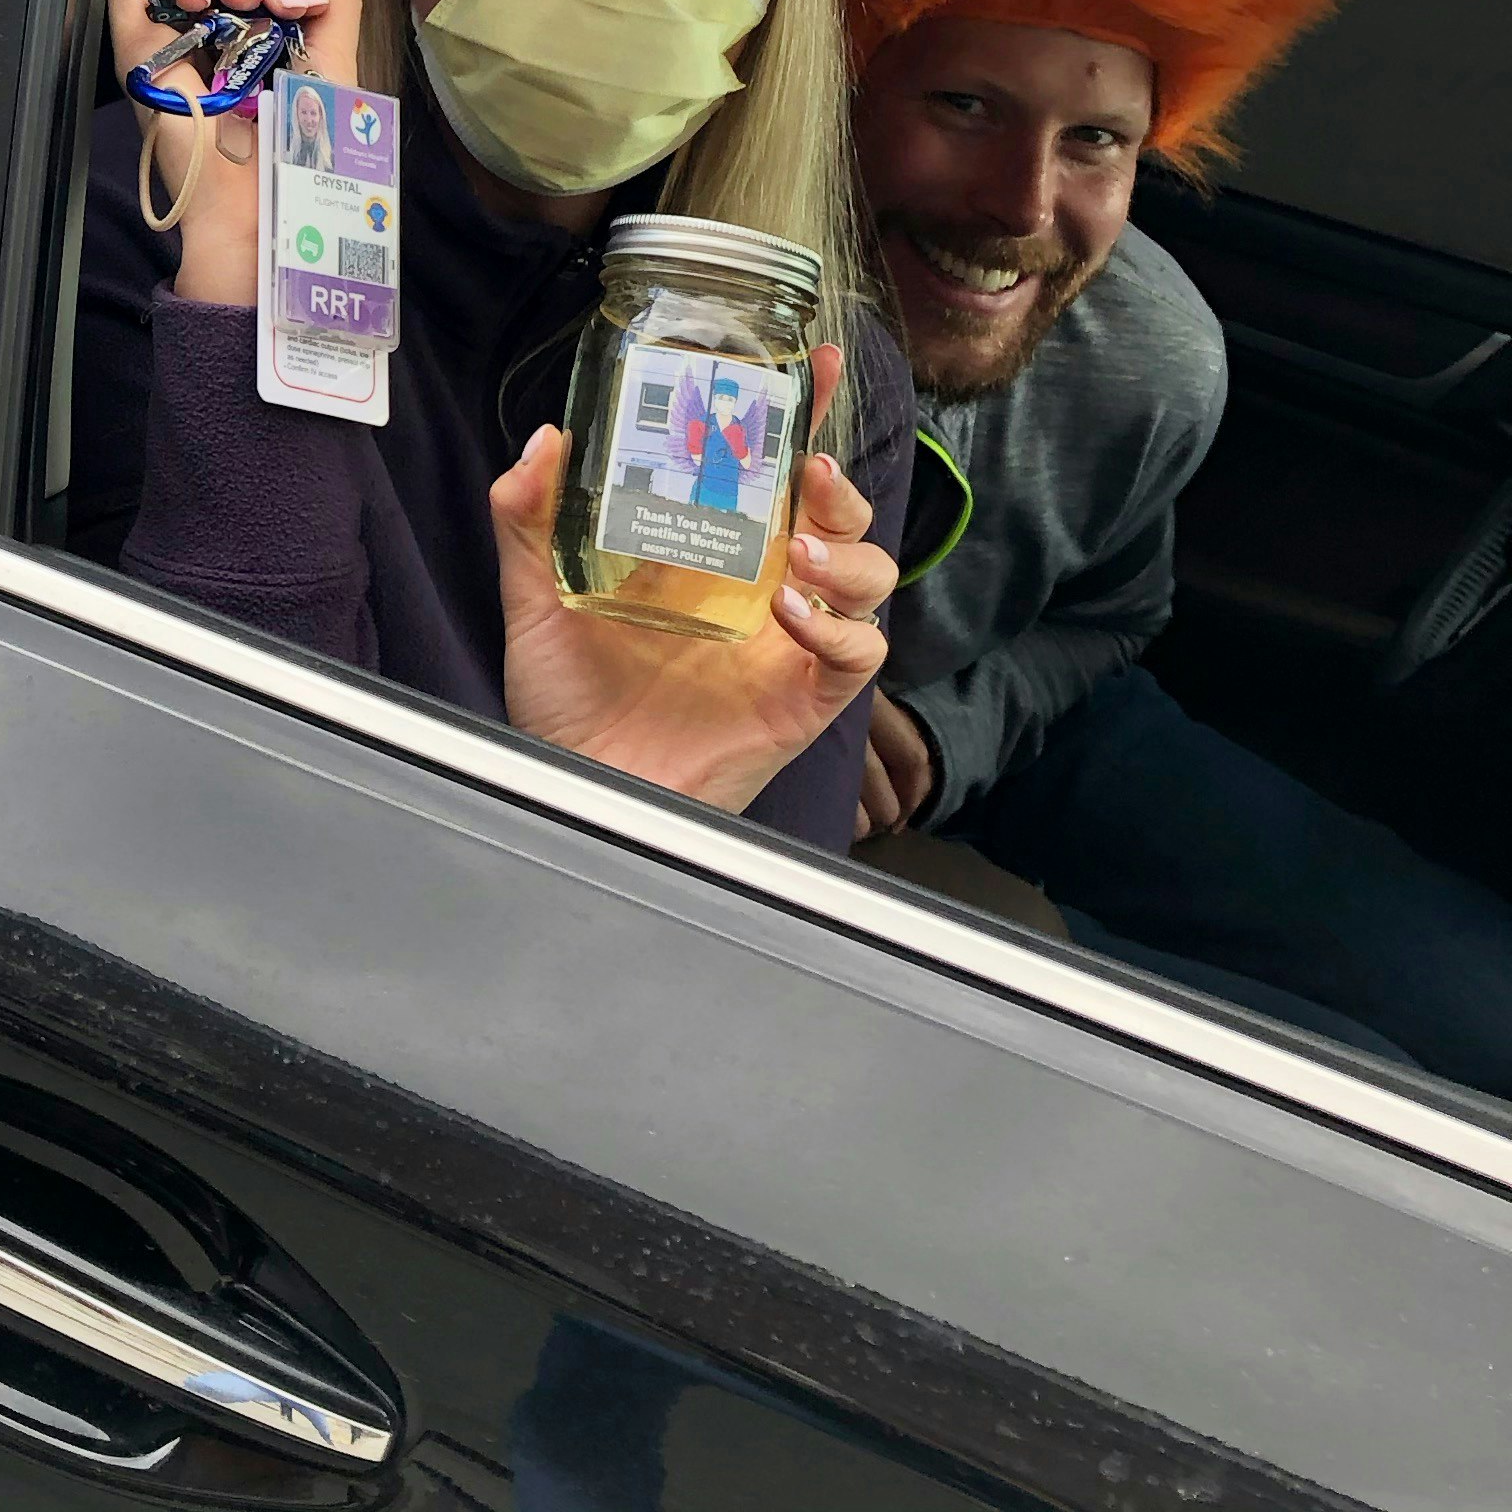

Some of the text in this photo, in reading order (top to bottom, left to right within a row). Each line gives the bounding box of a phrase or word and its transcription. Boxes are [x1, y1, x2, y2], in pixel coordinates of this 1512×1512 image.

[313, 174, 362, 195] CRYSTAL
[341, 201, 360, 213] TEAM
[310, 284, 366, 321] RRT
[630, 520, 687, 543] Frontline
[635, 505, 742, 541] Thank You Denver
[641, 542, 679, 558] BIGSBY'S
[679, 550, 704, 564] FOLLY
